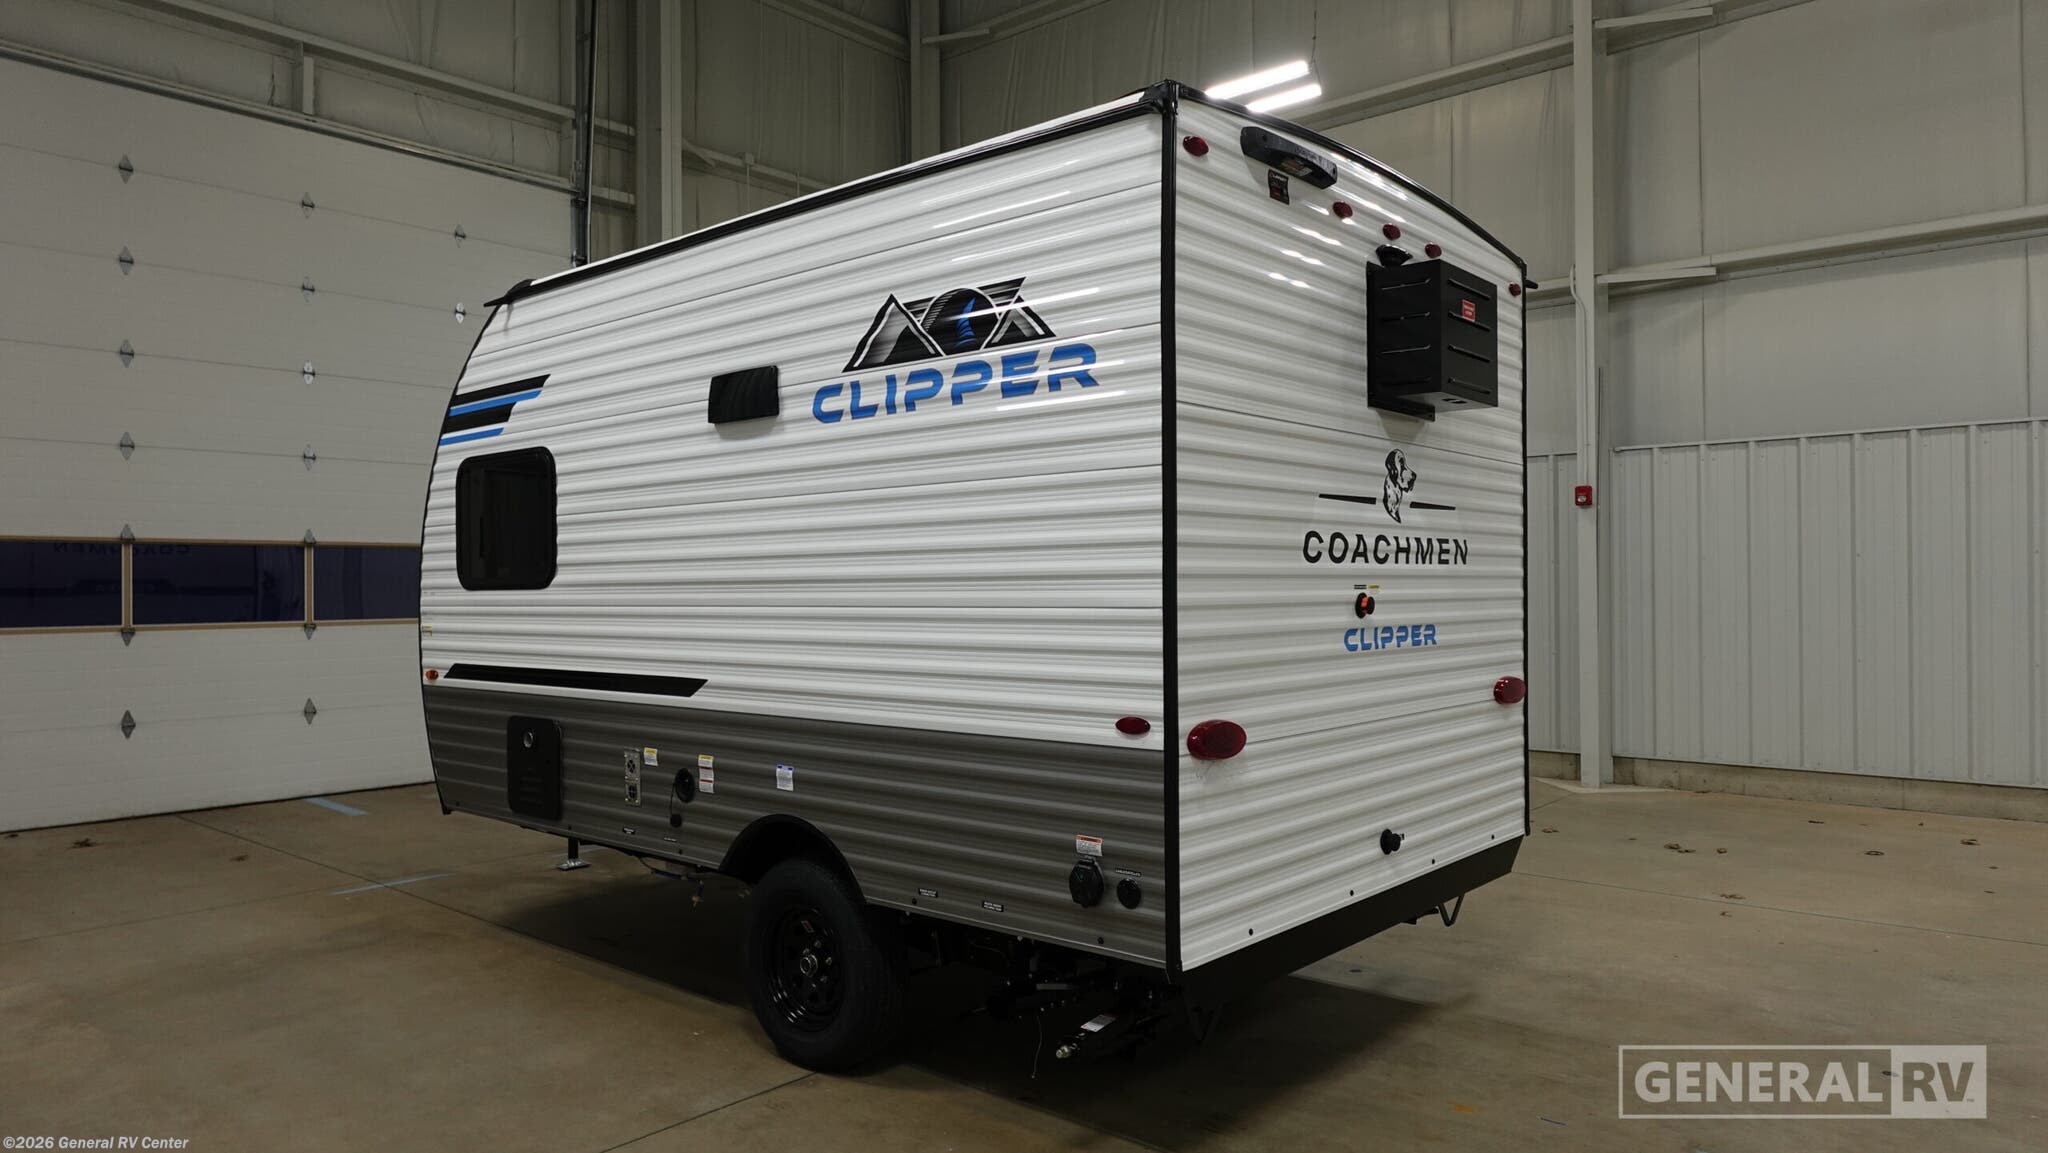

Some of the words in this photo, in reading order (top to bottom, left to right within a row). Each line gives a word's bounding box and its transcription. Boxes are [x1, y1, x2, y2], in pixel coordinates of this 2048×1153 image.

[812, 342, 1099, 424] CLIPPER
[1302, 530, 1469, 566] COACHMEN
[1343, 624, 1437, 652] CLIPPER
